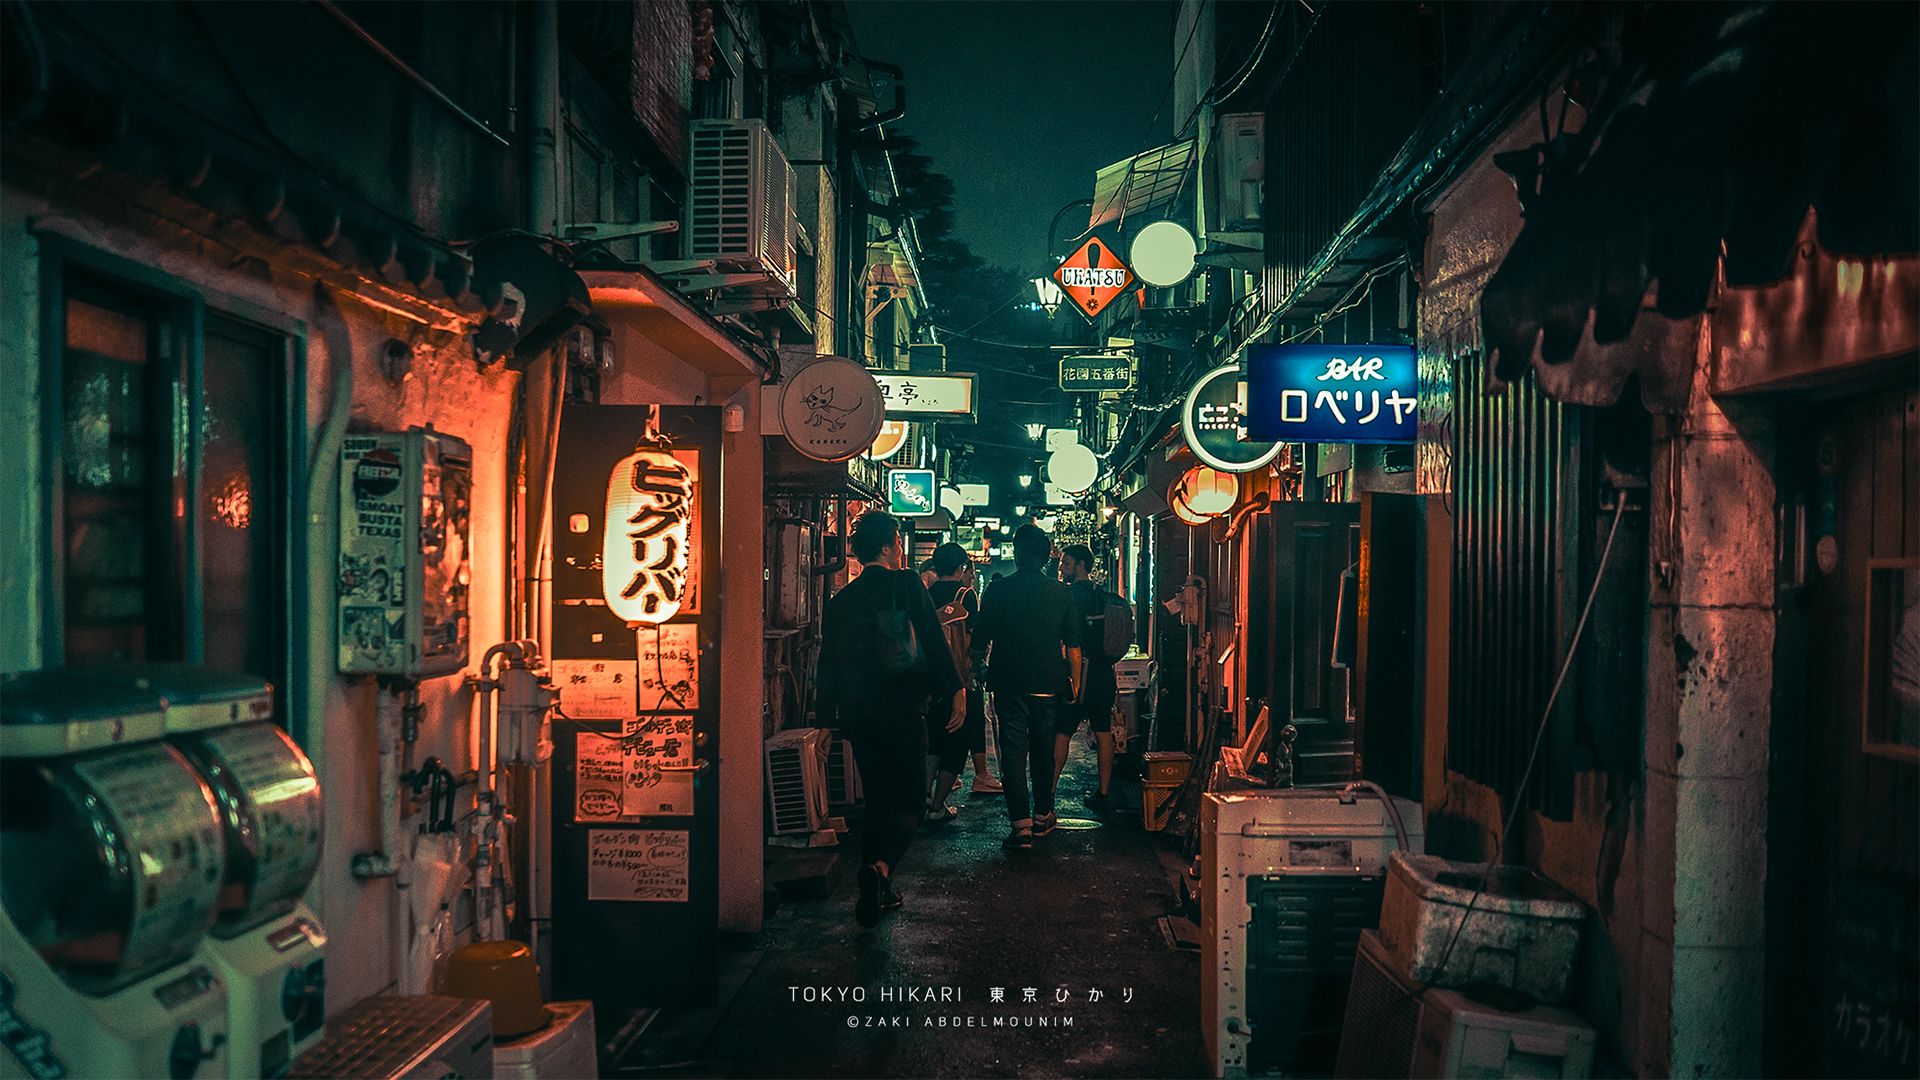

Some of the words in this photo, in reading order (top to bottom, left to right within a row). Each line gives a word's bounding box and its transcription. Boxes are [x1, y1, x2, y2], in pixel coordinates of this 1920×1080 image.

[1062, 268, 1125, 287] URATSU
[1316, 357, 1388, 381] BAR
[1281, 389, 1418, 425] ロベリヤ
[620, 460, 690, 614] ビッグリバー
